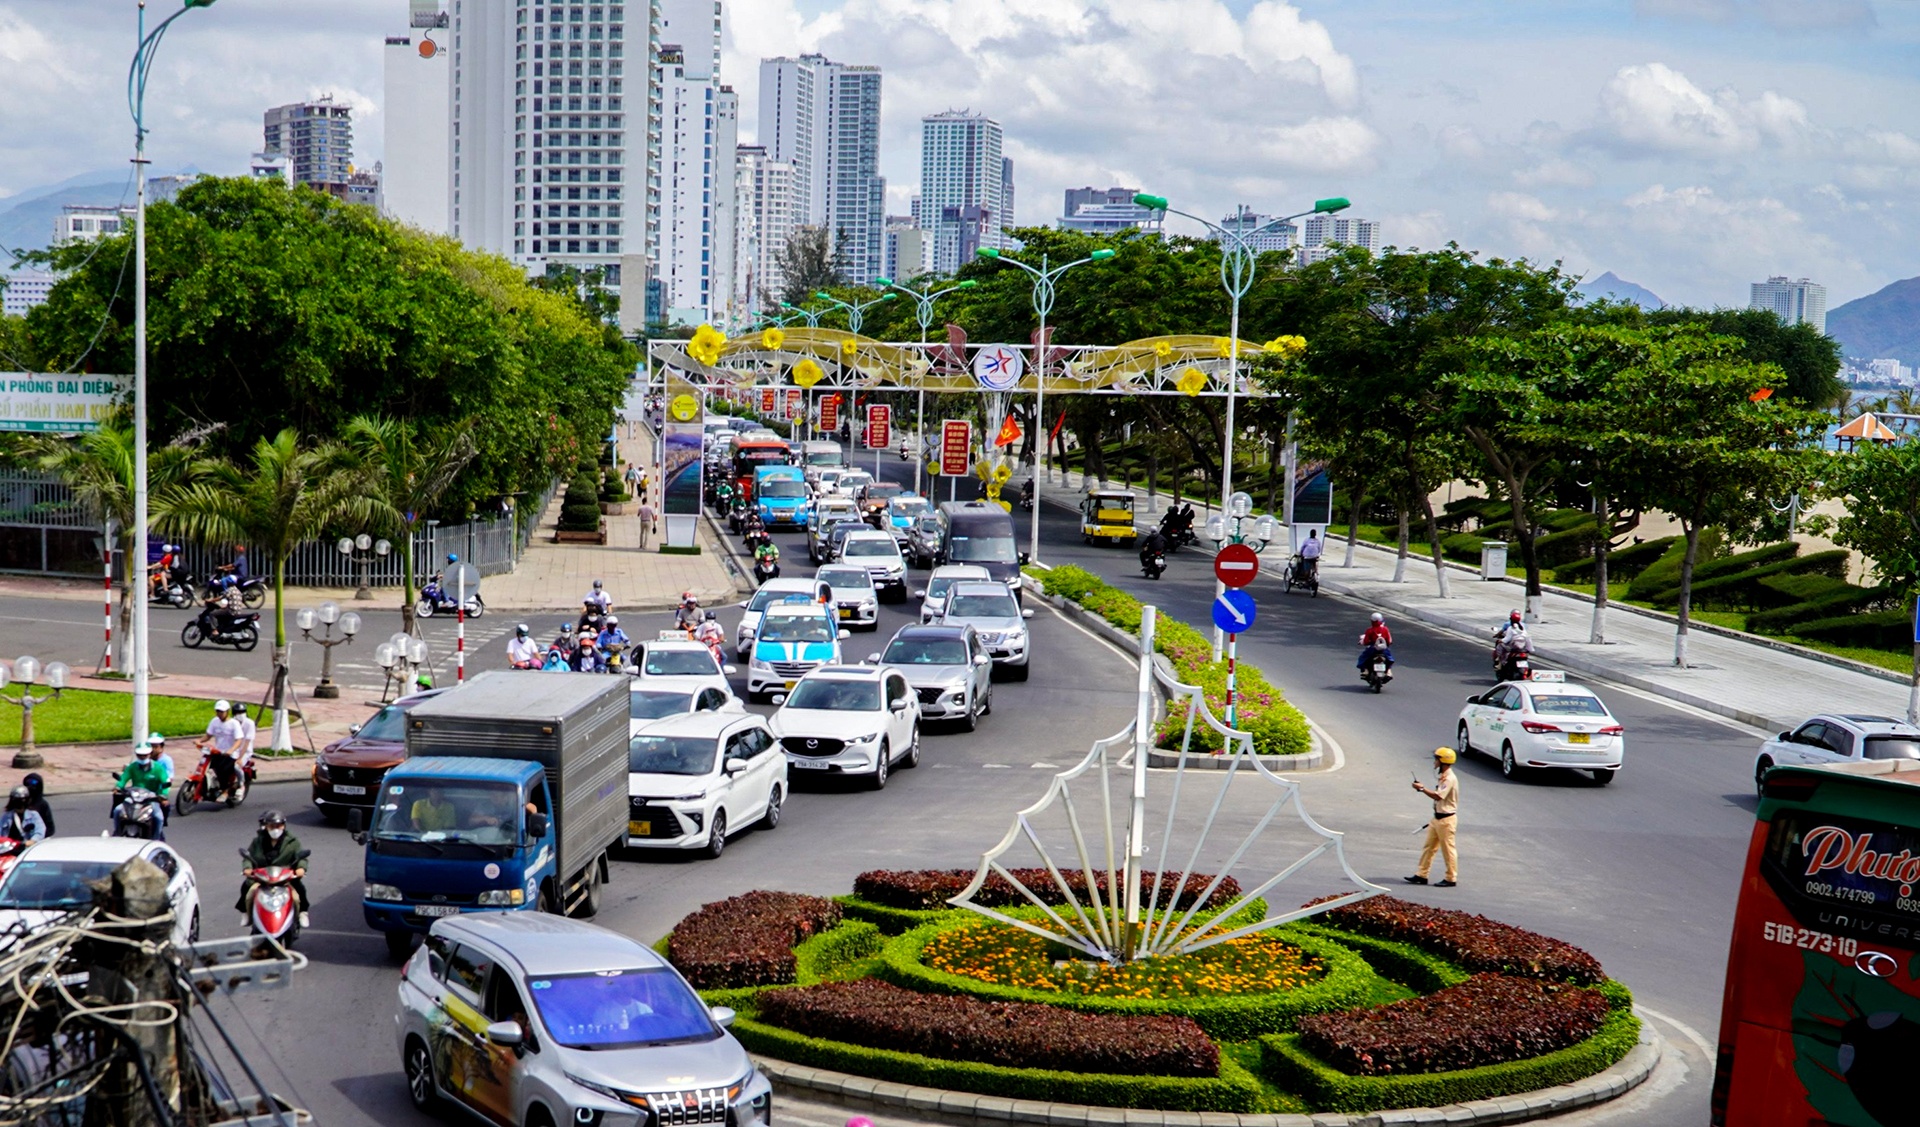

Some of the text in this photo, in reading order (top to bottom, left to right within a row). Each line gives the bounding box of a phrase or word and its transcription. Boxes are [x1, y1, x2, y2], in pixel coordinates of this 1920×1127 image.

[57, 381, 79, 397] ĐẠI
[83, 378, 113, 397] DIỆN
[1806, 880, 1875, 904] 0902.474799
